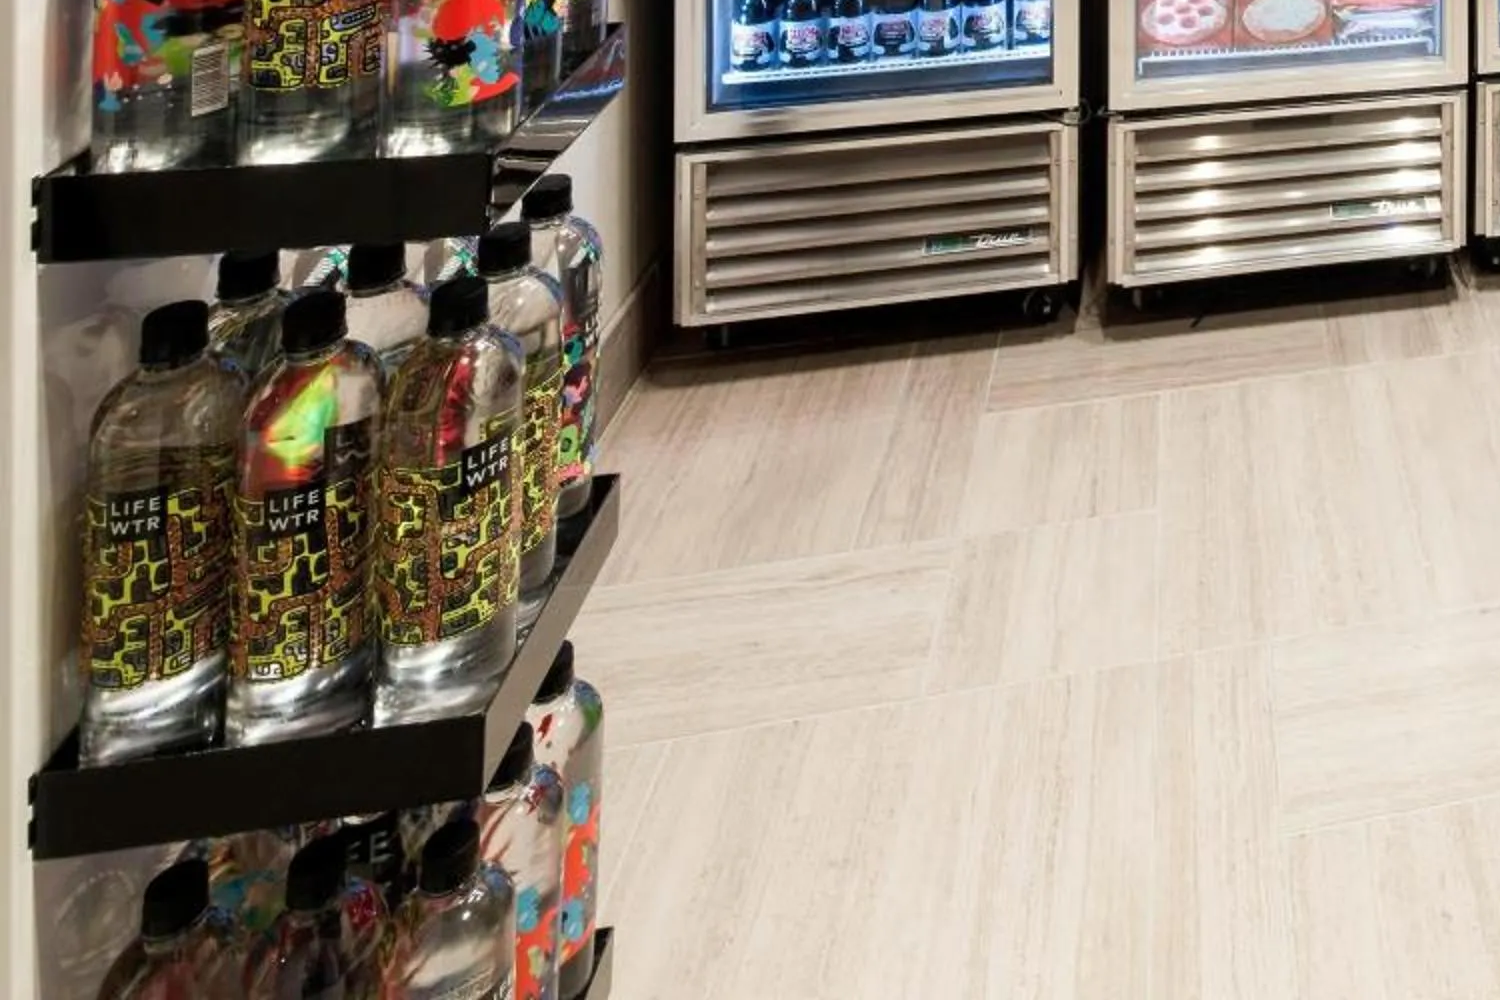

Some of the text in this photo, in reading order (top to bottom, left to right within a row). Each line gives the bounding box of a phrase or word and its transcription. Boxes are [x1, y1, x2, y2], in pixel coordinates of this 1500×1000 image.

[466, 437, 510, 470] LIFE
[466, 456, 509, 488] WTR
[110, 496, 162, 517] LIFE
[268, 488, 320, 514] LIFE
[109, 515, 162, 536] WTR
[268, 507, 320, 533] WTR
